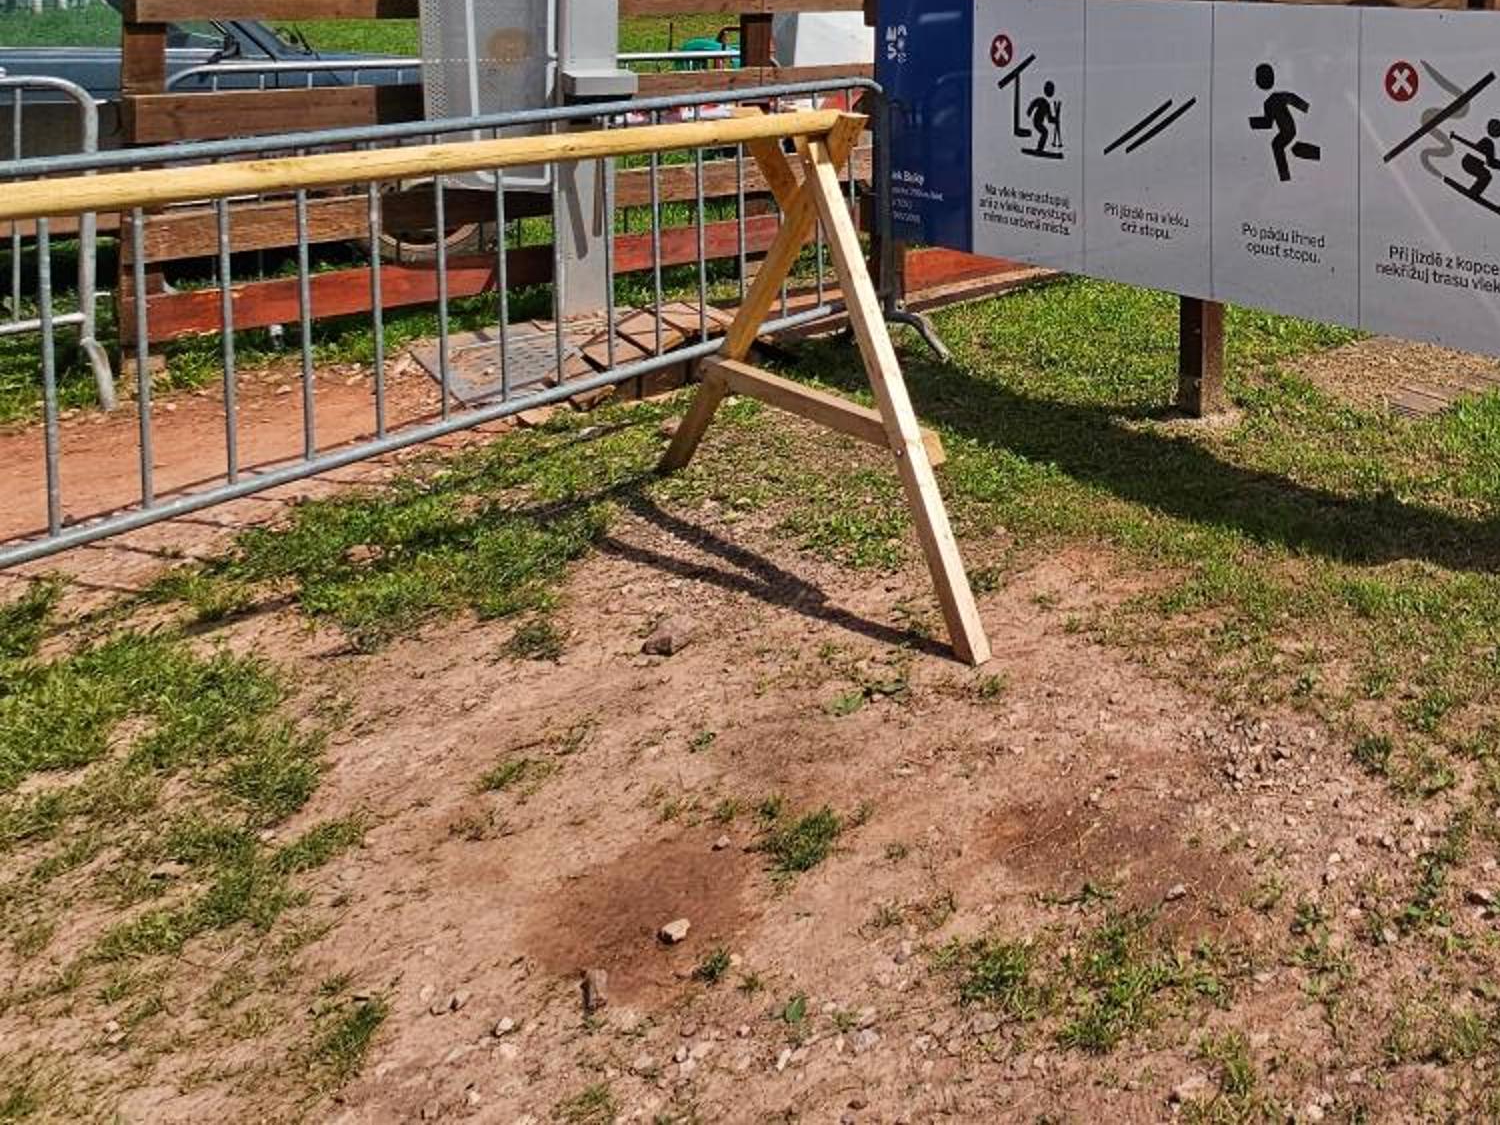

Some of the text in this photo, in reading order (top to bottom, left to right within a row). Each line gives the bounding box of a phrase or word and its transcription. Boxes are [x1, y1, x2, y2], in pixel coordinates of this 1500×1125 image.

[1146, 211, 1159, 224] na
[1242, 221, 1325, 248] Po pádu ihned
[1282, 246, 1321, 264] stopu.
[1389, 244, 1409, 261] Při
[1445, 256, 1453, 269] z
[1456, 256, 1500, 276] kopce
[1432, 269, 1469, 288] trasu
